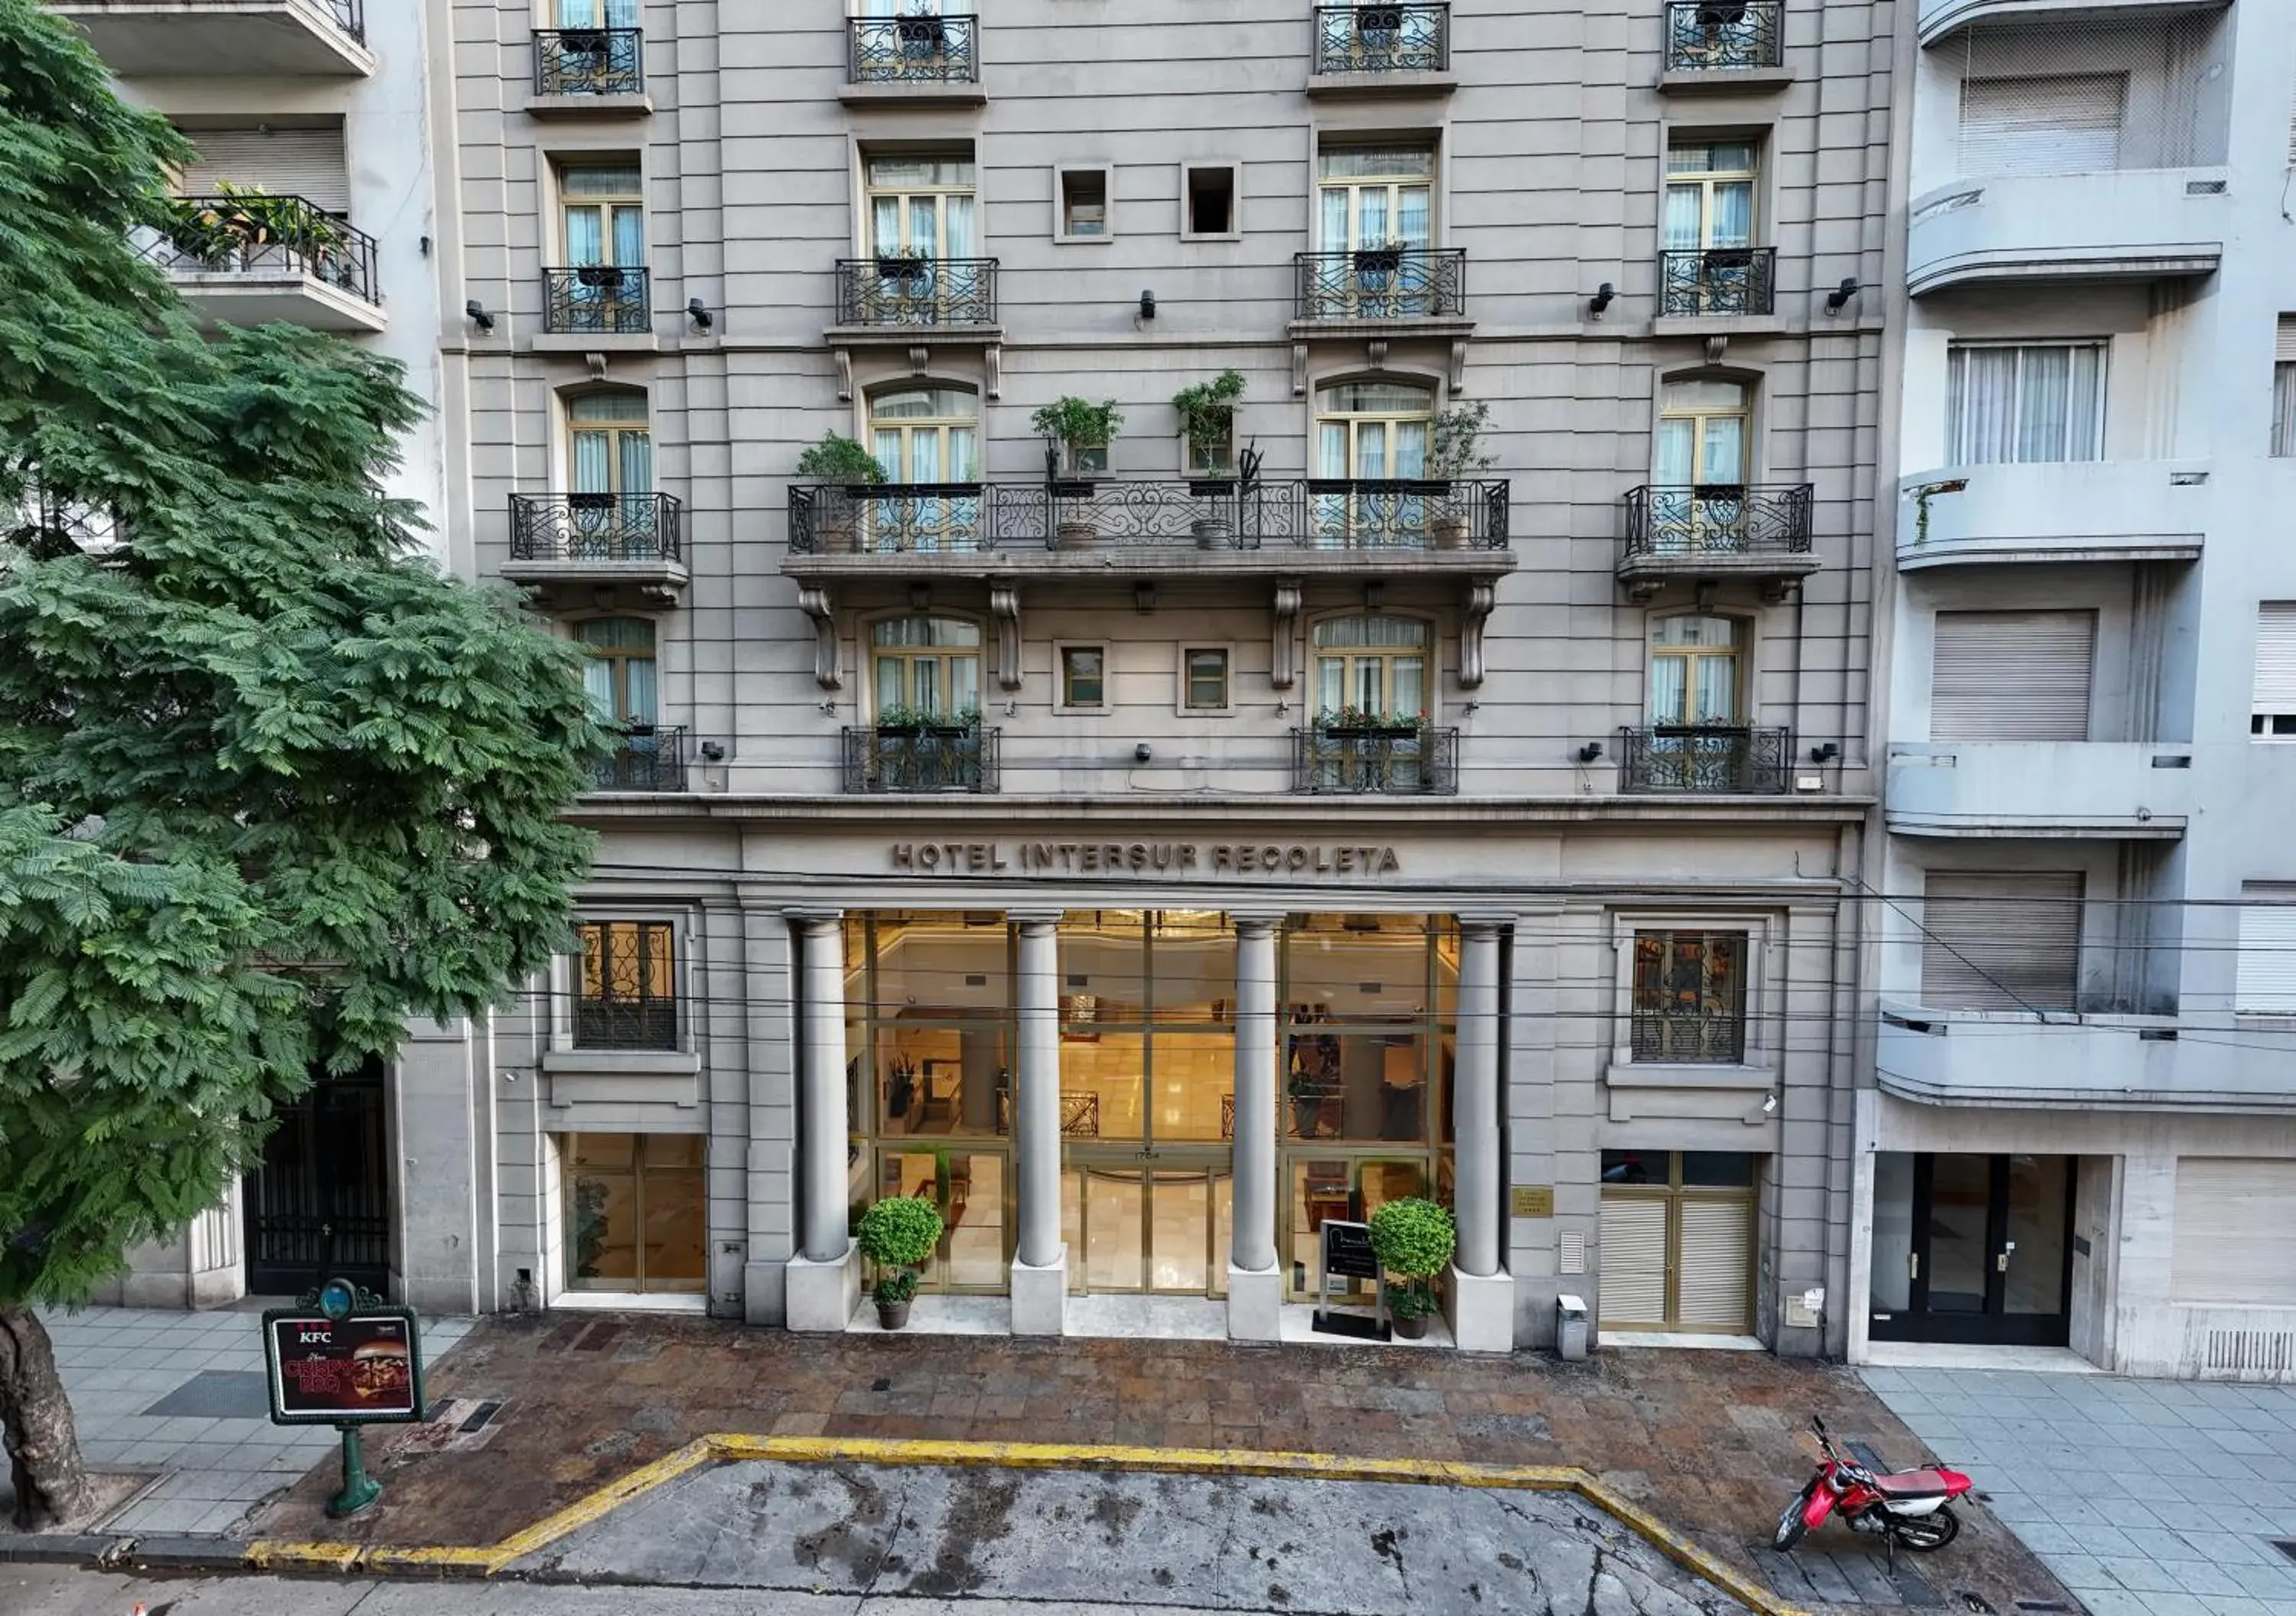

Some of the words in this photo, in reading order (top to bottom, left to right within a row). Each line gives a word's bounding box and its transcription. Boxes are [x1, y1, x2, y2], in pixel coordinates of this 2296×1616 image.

[894, 843, 1006, 869] HOTEL
[1019, 843, 1196, 870] INTERSUR
[1213, 845, 1400, 871] RECOLETA
[299, 1332, 331, 1343] KFC
